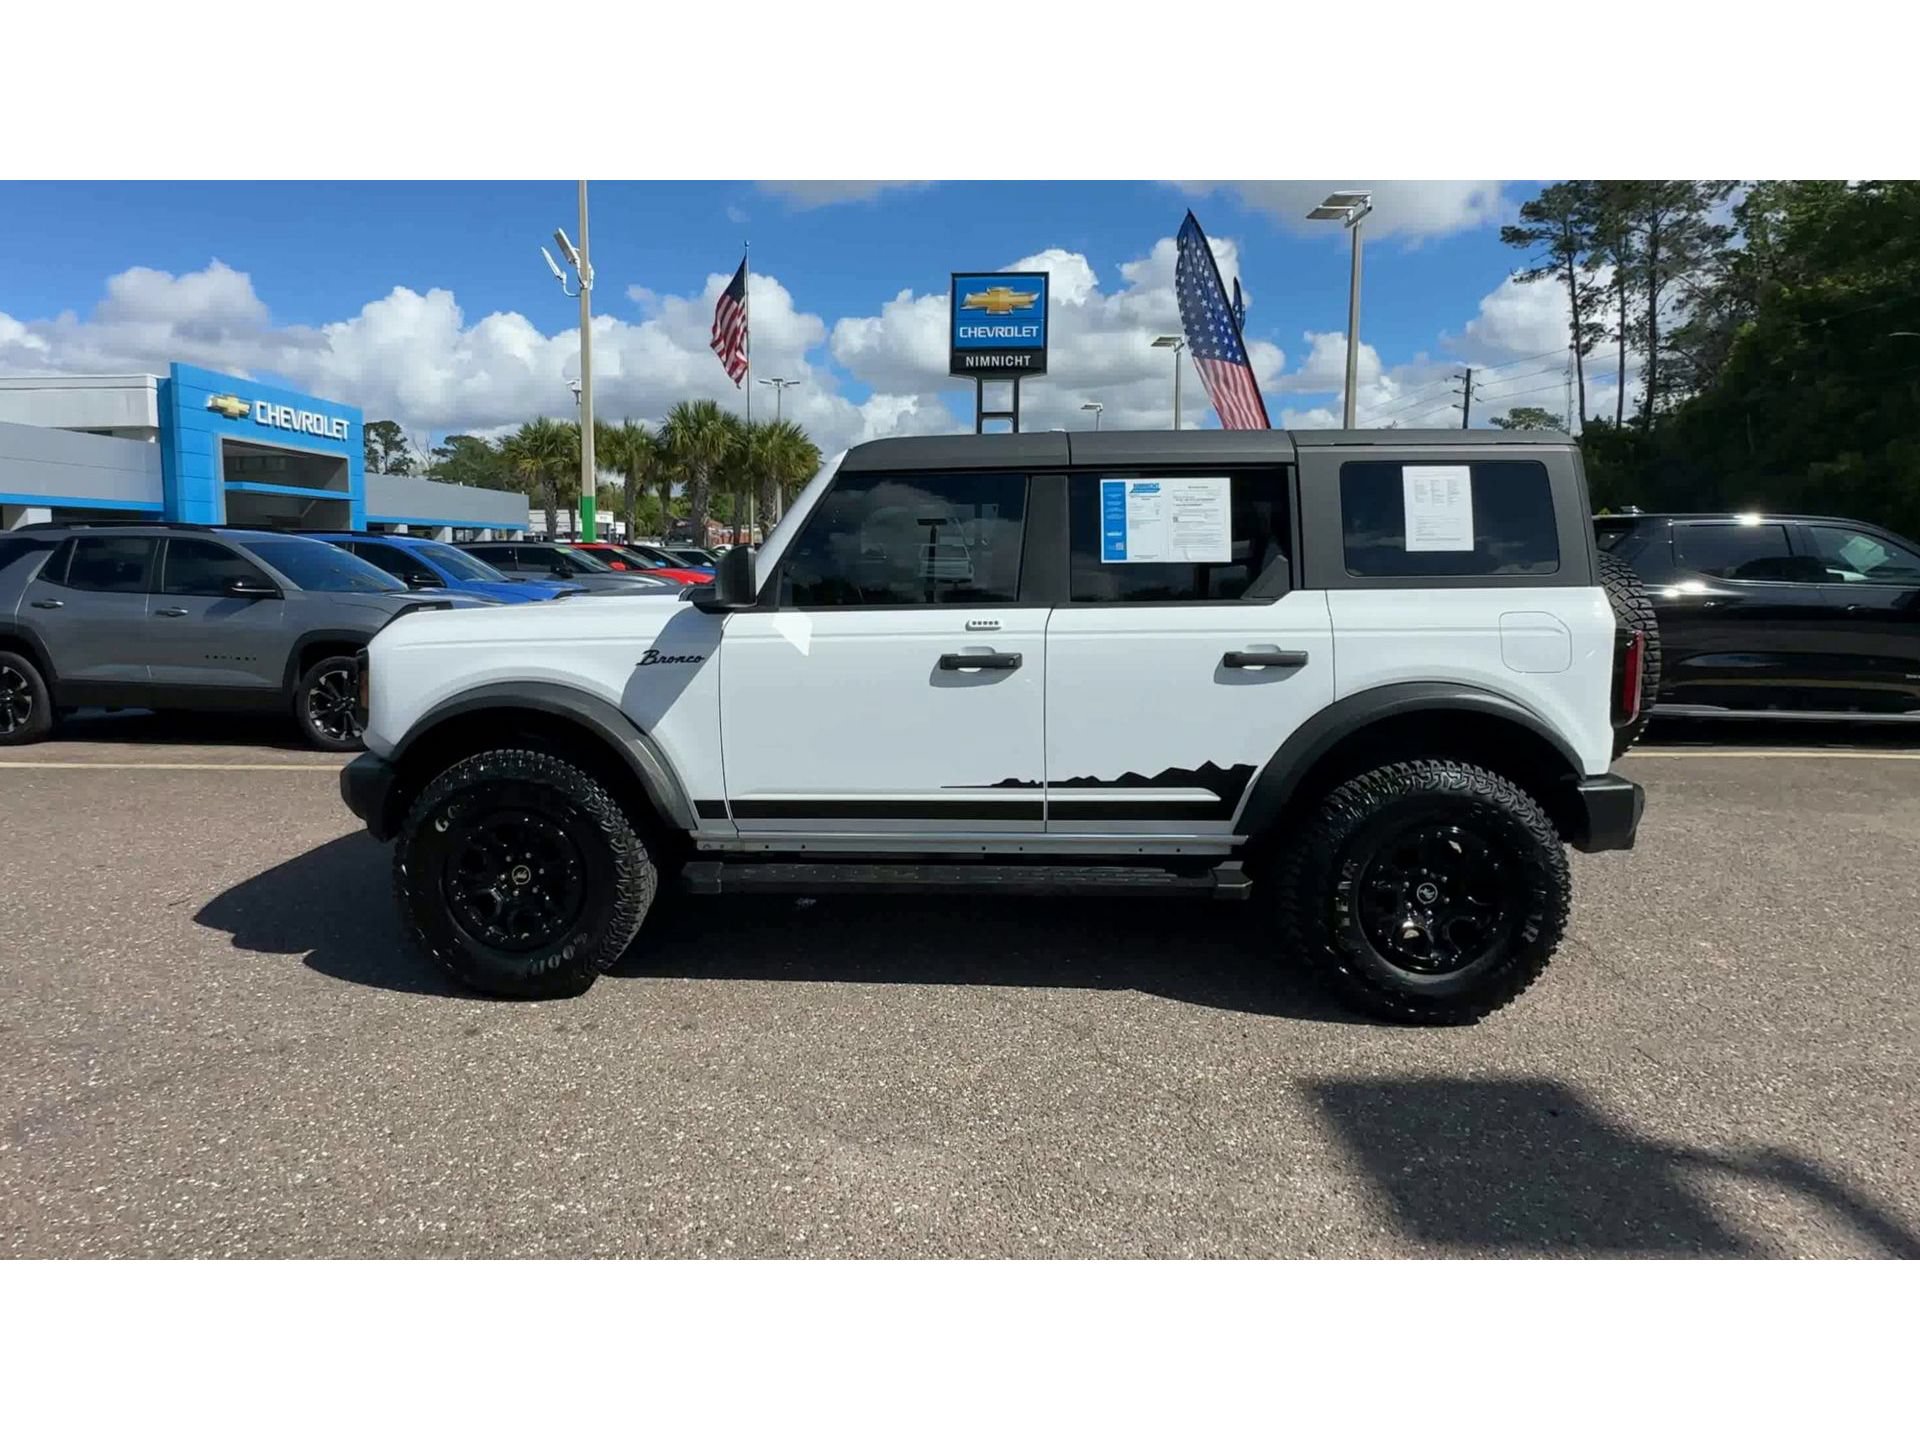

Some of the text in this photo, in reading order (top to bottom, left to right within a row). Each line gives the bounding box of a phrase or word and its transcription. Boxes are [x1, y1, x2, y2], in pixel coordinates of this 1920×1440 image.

[960, 326, 1039, 338] CHEVROLET
[965, 355, 1031, 367] NIMNICHT
[256, 401, 350, 440] CHEVROLET
[635, 649, 705, 666] Bronco
